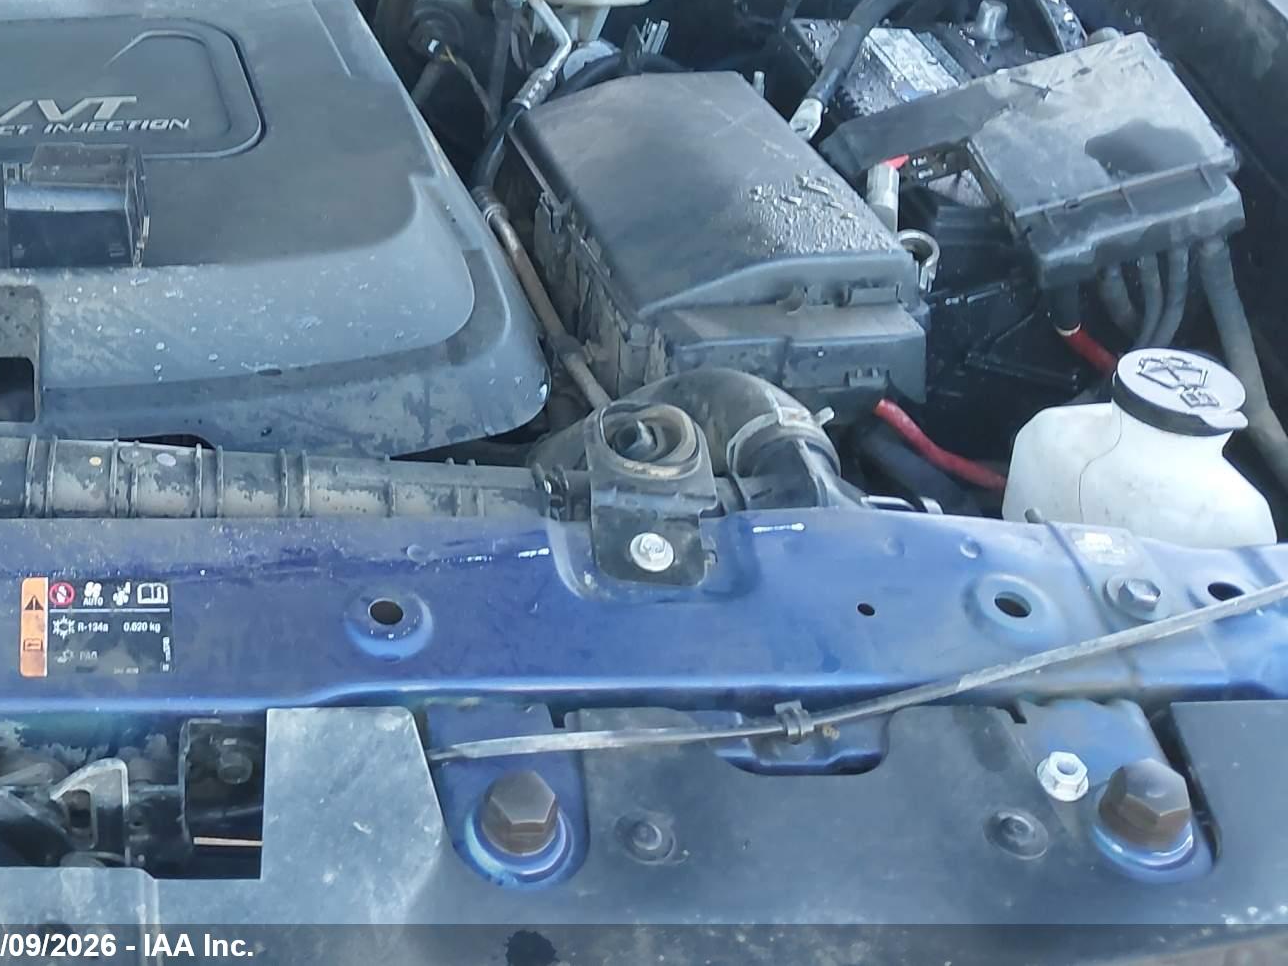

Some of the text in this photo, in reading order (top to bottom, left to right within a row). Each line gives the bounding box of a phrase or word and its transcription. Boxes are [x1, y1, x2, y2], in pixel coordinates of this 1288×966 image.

[43, 117, 191, 135] INJECTION
[82, 596, 104, 607] AUTO
[77, 621, 109, 633] R-134a
[149, 621, 161, 634] kg
